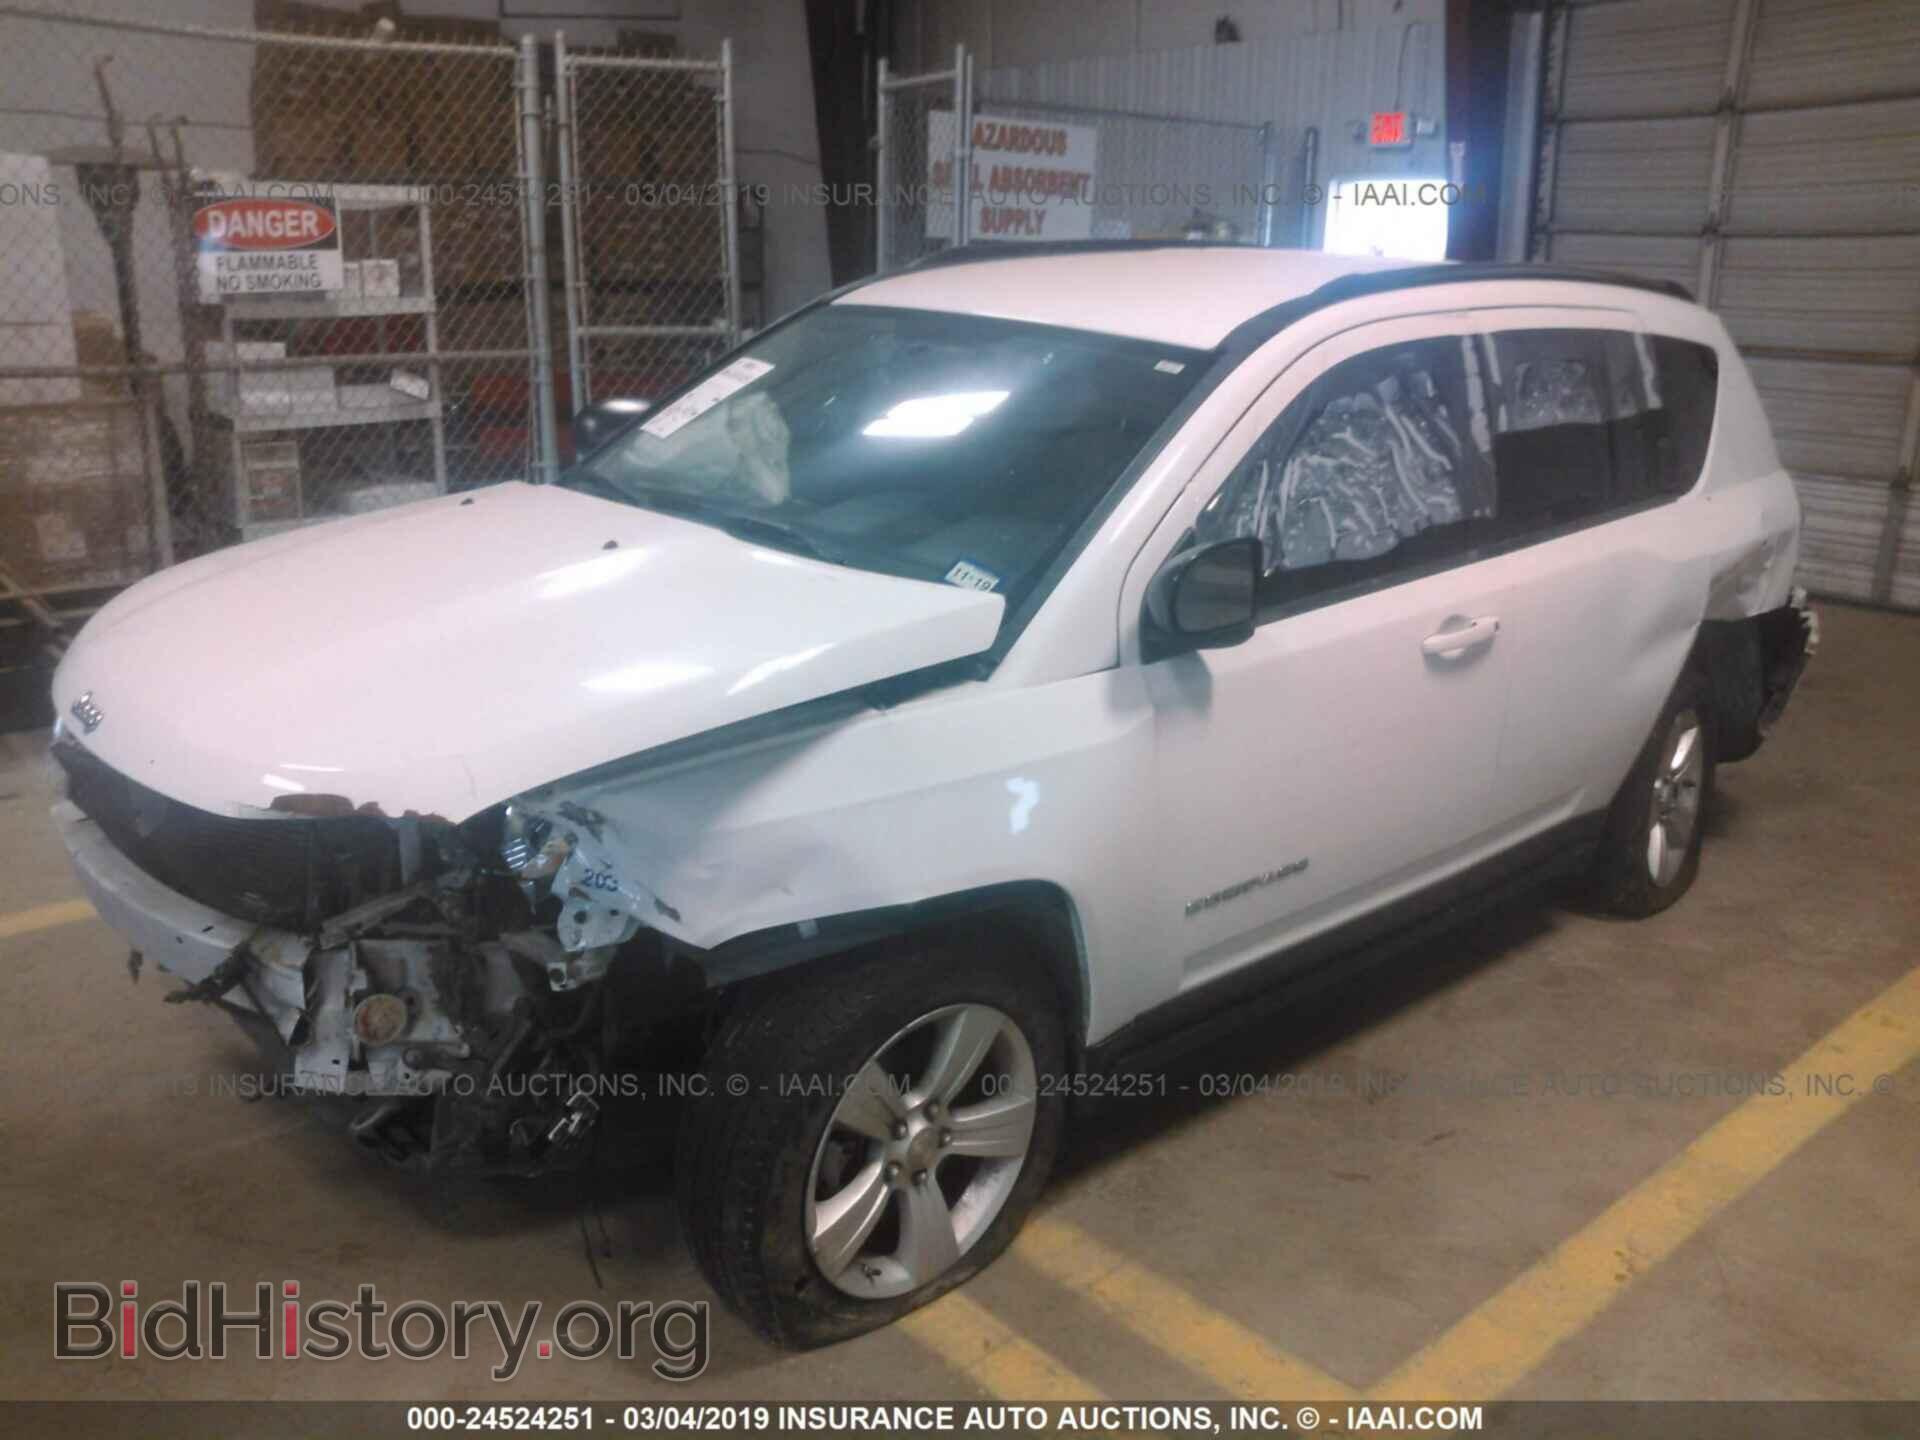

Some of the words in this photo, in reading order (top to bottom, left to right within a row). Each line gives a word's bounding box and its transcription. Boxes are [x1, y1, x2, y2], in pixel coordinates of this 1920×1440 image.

[971, 122, 1067, 156] AZARDOUS
[206, 209, 319, 239] DANGER
[980, 207, 1046, 235] SUPPLY
[216, 253, 320, 271] FLAMMABLE
[217, 274, 241, 291] NO
[245, 273, 322, 291] SMOKING
